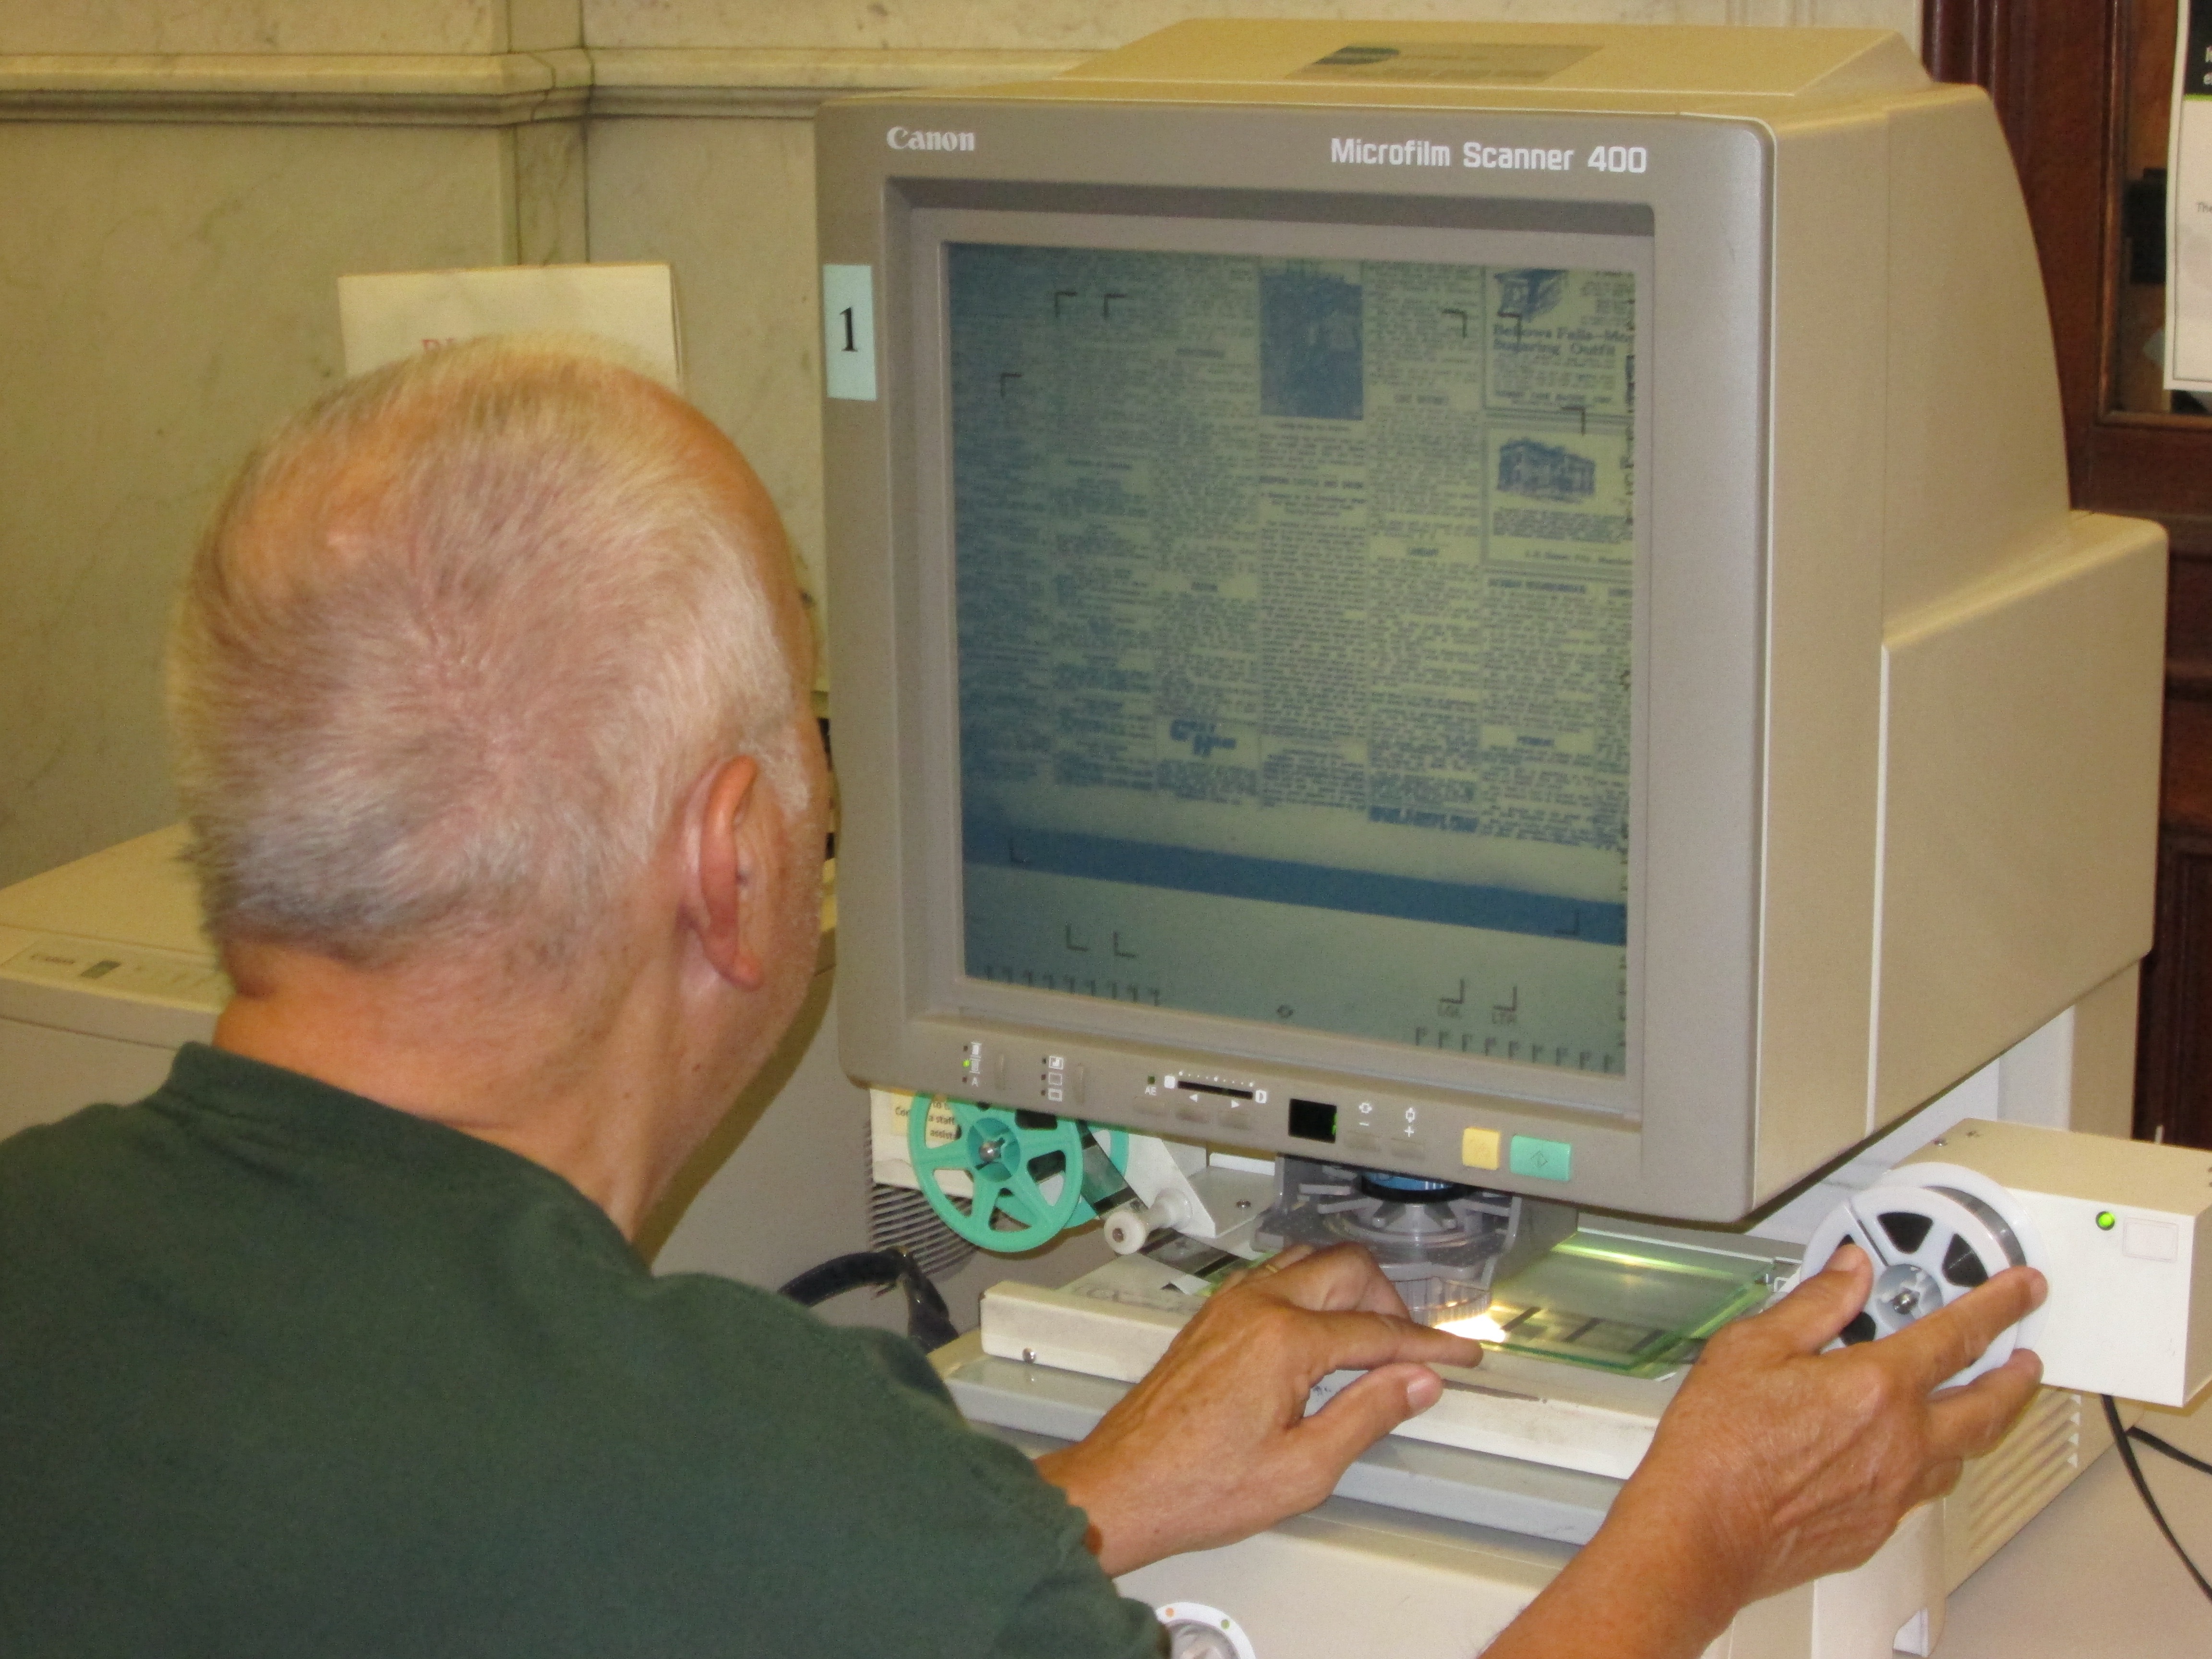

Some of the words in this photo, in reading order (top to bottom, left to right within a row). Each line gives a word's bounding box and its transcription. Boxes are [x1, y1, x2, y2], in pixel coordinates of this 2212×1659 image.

[887, 126, 975, 151] Canon
[1331, 138, 1450, 167] Microfilm
[1463, 142, 1574, 170] Scanner
[1587, 145, 1647, 173] 400
[840, 306, 858, 352] 1
[1145, 1086, 1157, 1095] AE
